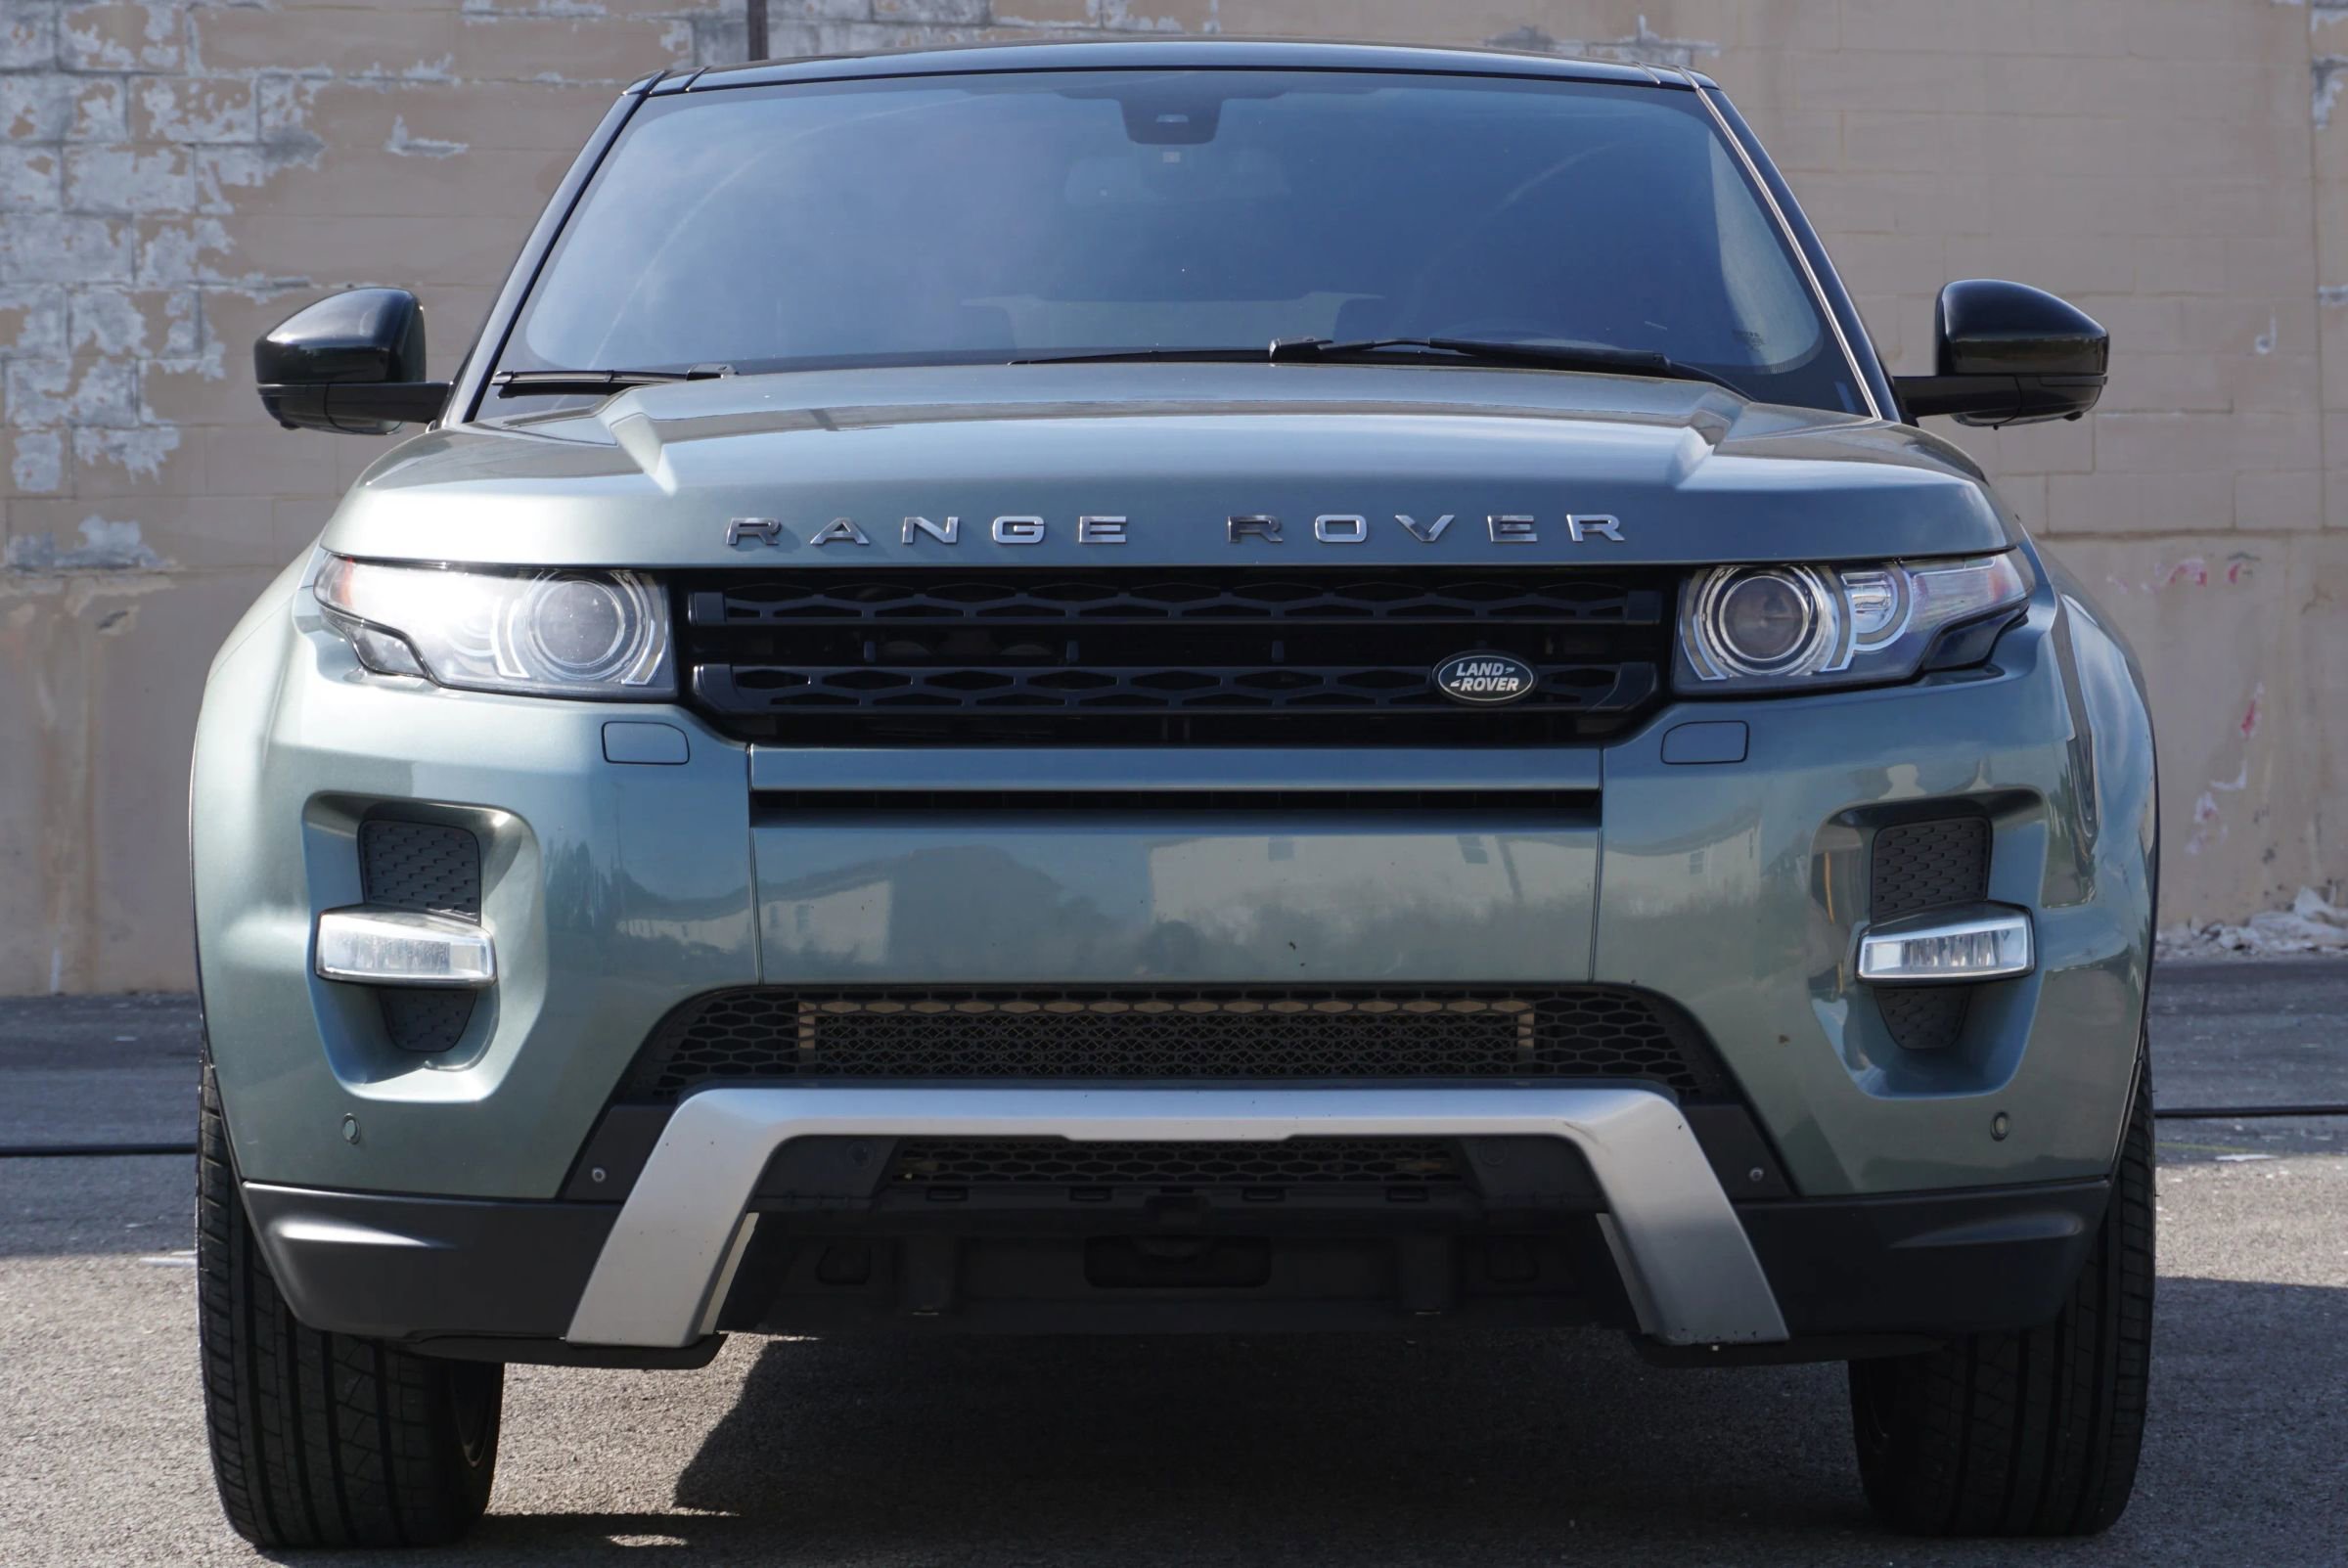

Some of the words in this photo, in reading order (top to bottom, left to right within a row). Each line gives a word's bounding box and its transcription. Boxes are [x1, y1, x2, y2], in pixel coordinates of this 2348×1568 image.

[726, 515, 1127, 545] RANGE
[1227, 515, 1625, 543] ROVER
[1456, 662, 1504, 676] LAND
[1461, 677, 1518, 691] ROVER
